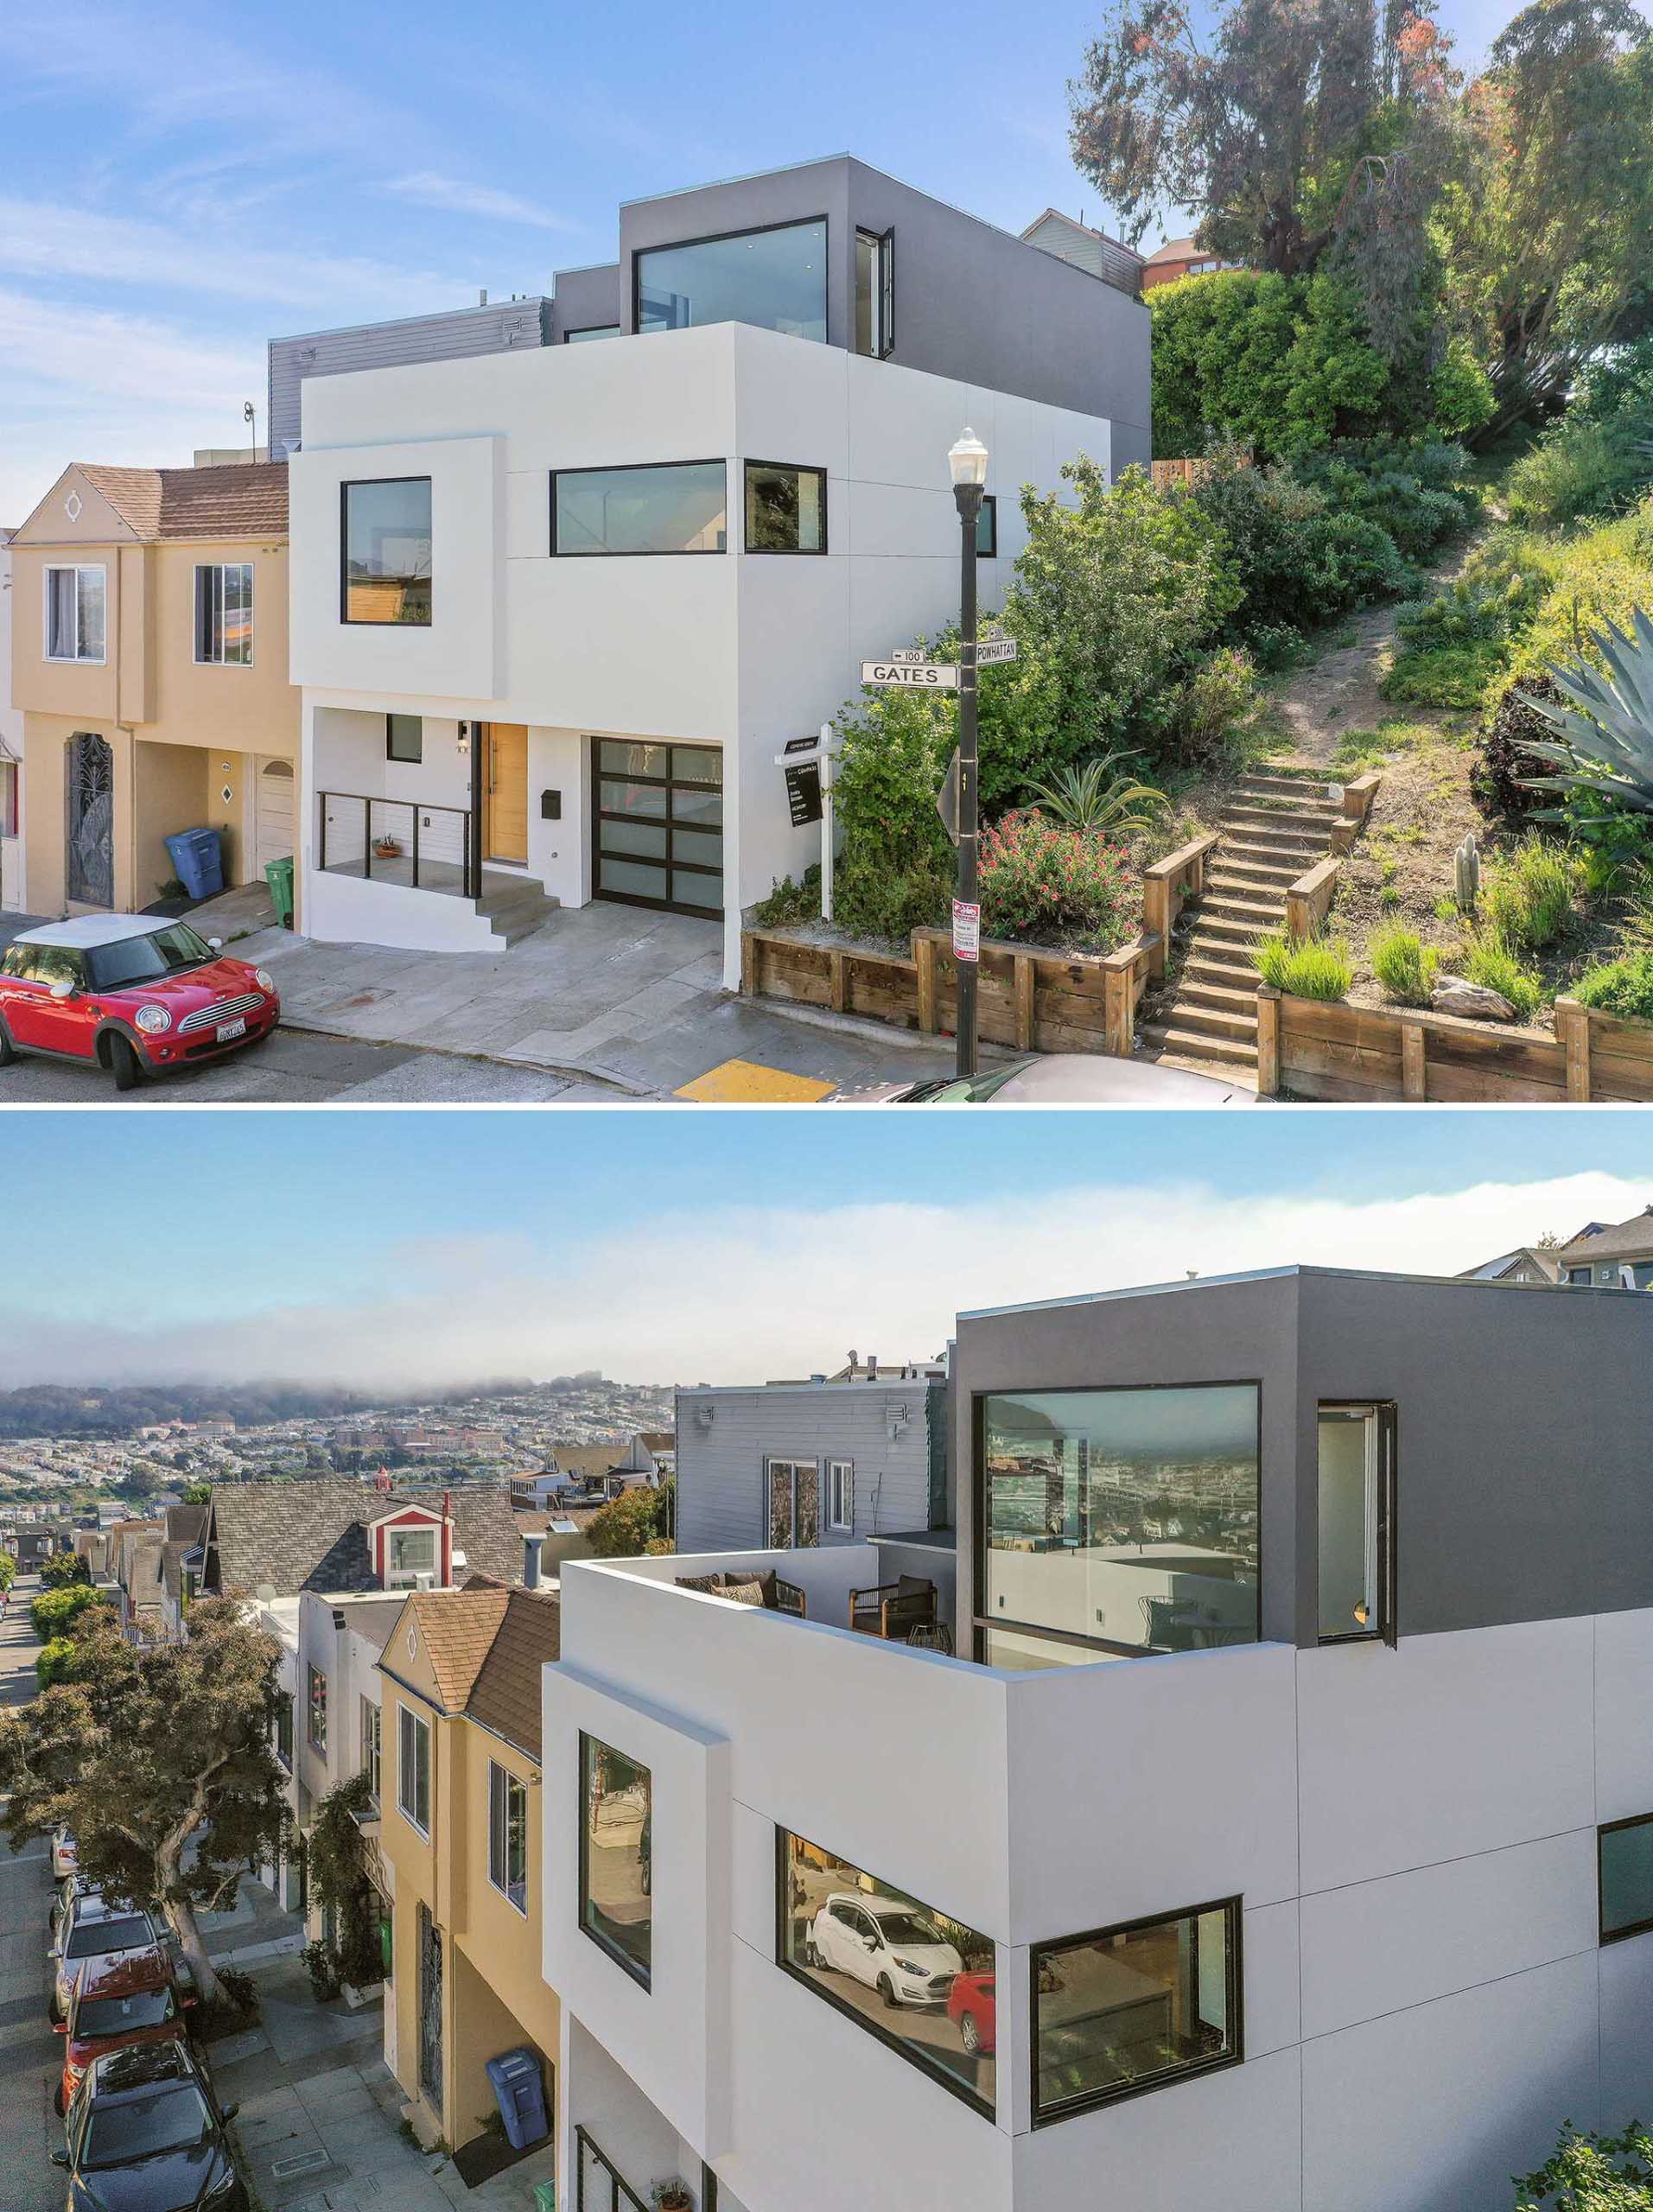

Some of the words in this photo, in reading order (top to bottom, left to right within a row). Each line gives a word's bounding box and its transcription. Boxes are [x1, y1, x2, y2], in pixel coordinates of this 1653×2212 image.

[905, 652, 920, 662] 100
[977, 642, 1015, 661] POWHATTAN
[874, 666, 938, 683] GATES
